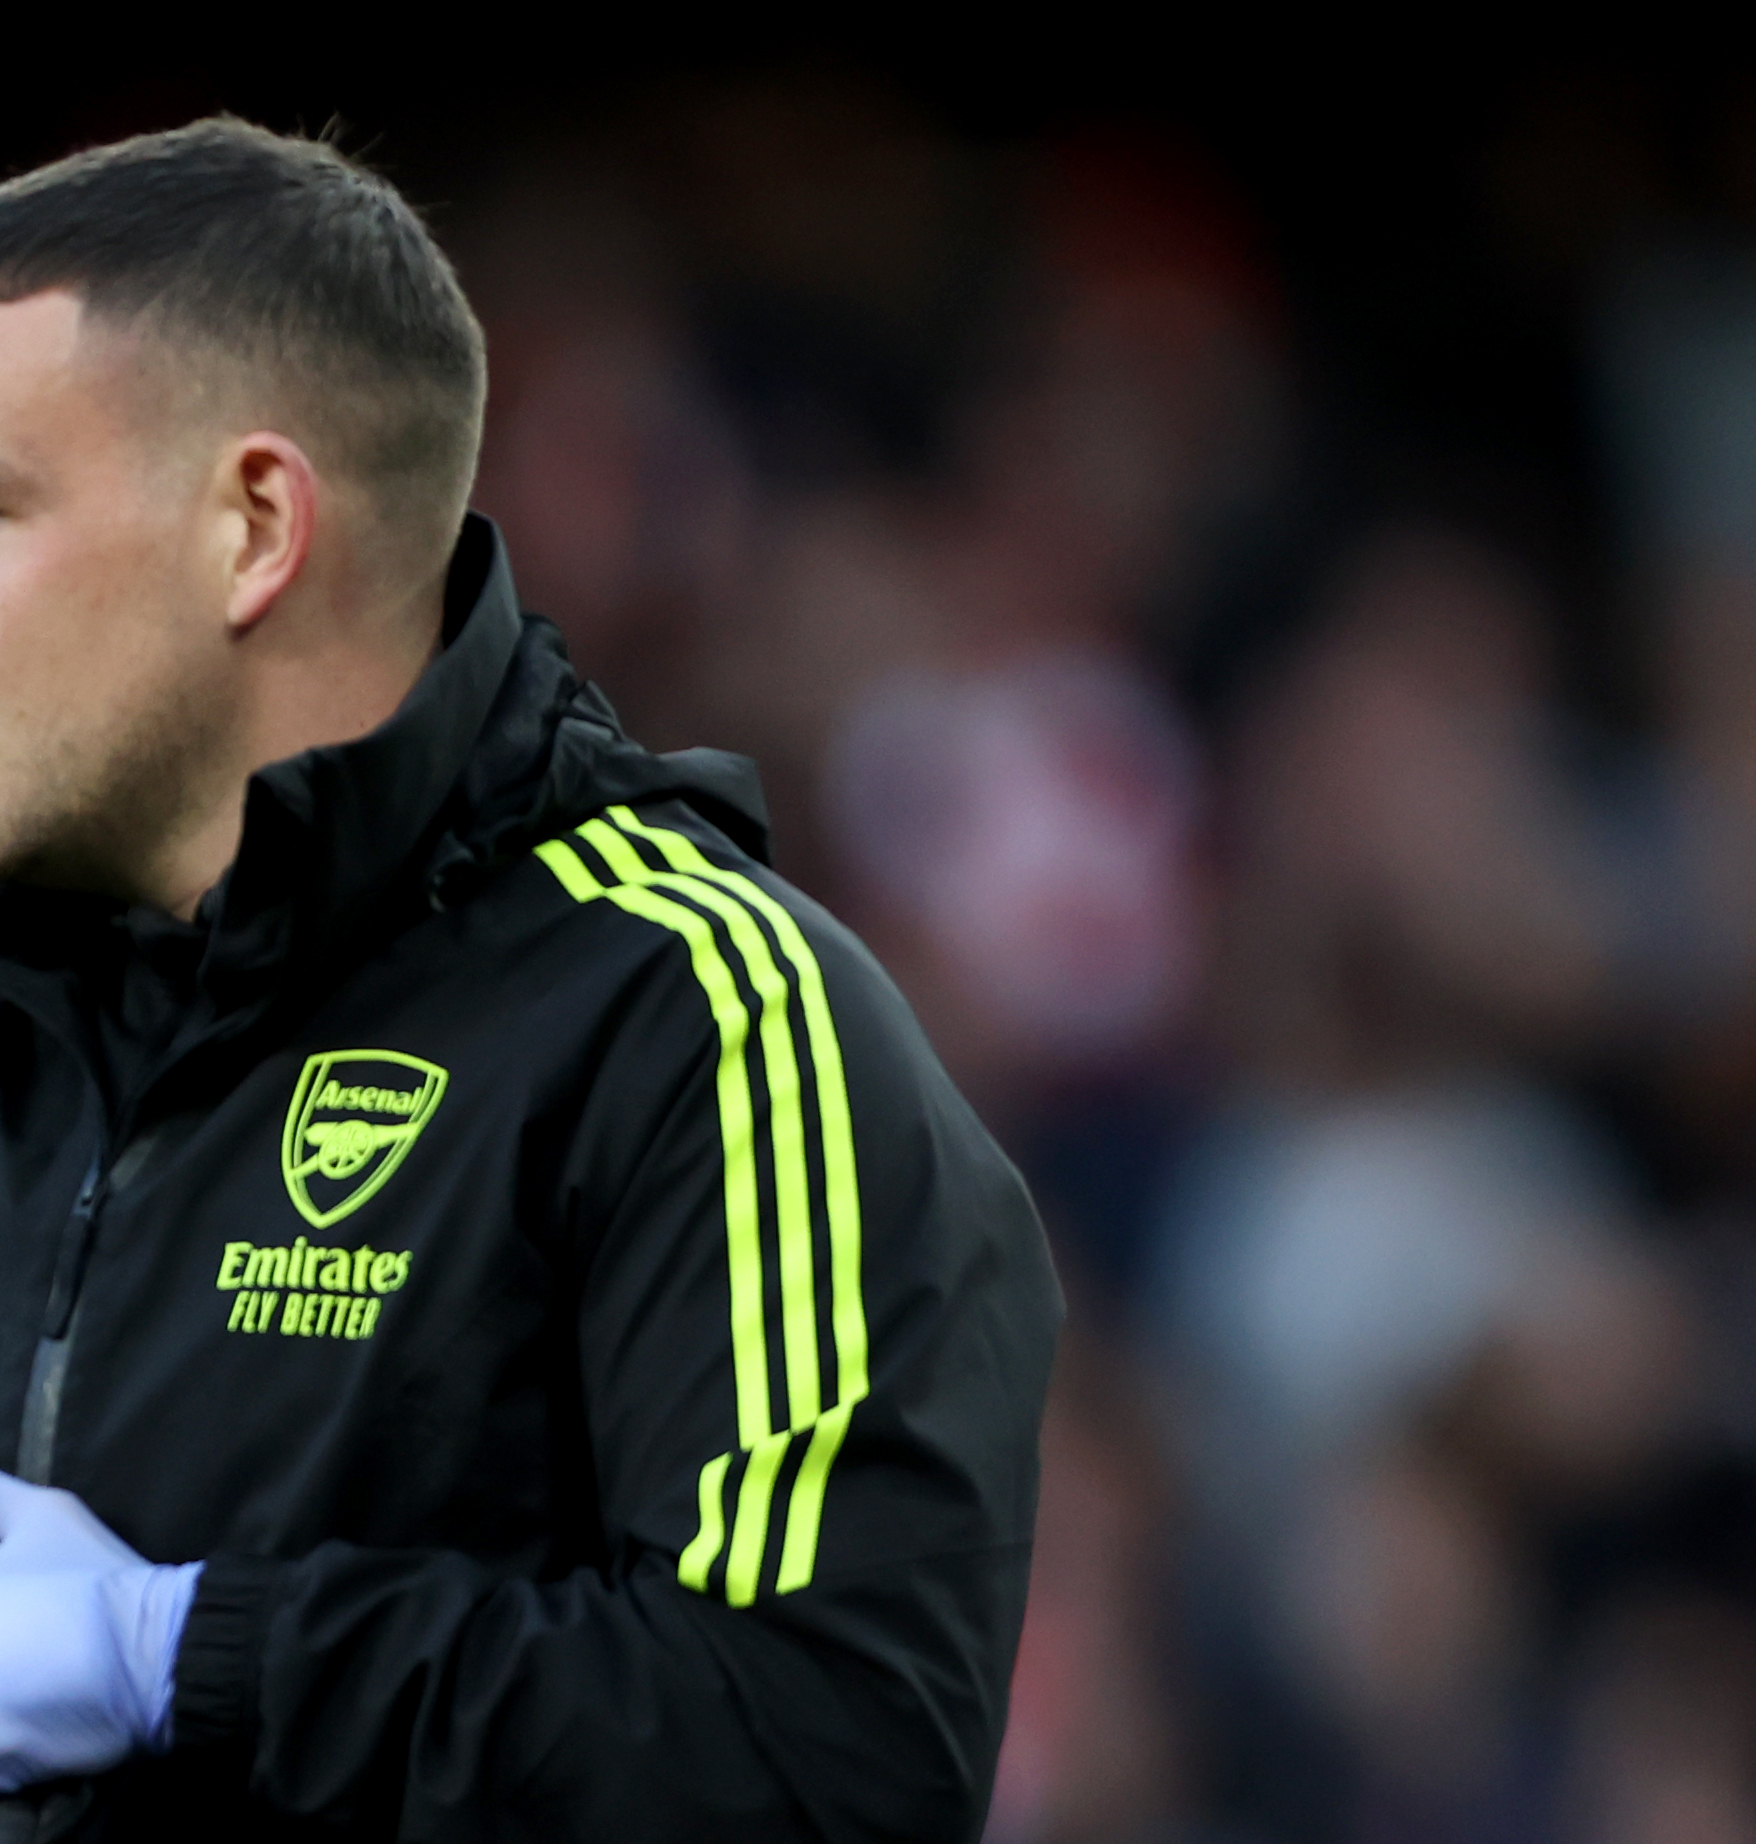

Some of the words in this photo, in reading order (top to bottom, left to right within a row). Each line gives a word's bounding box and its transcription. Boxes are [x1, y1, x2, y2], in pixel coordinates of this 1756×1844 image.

[315, 1079, 425, 1116] Arsenal
[216, 1235, 414, 1295] Emirates
[226, 1290, 281, 1334] FLY
[279, 1291, 382, 1341] BETTER
